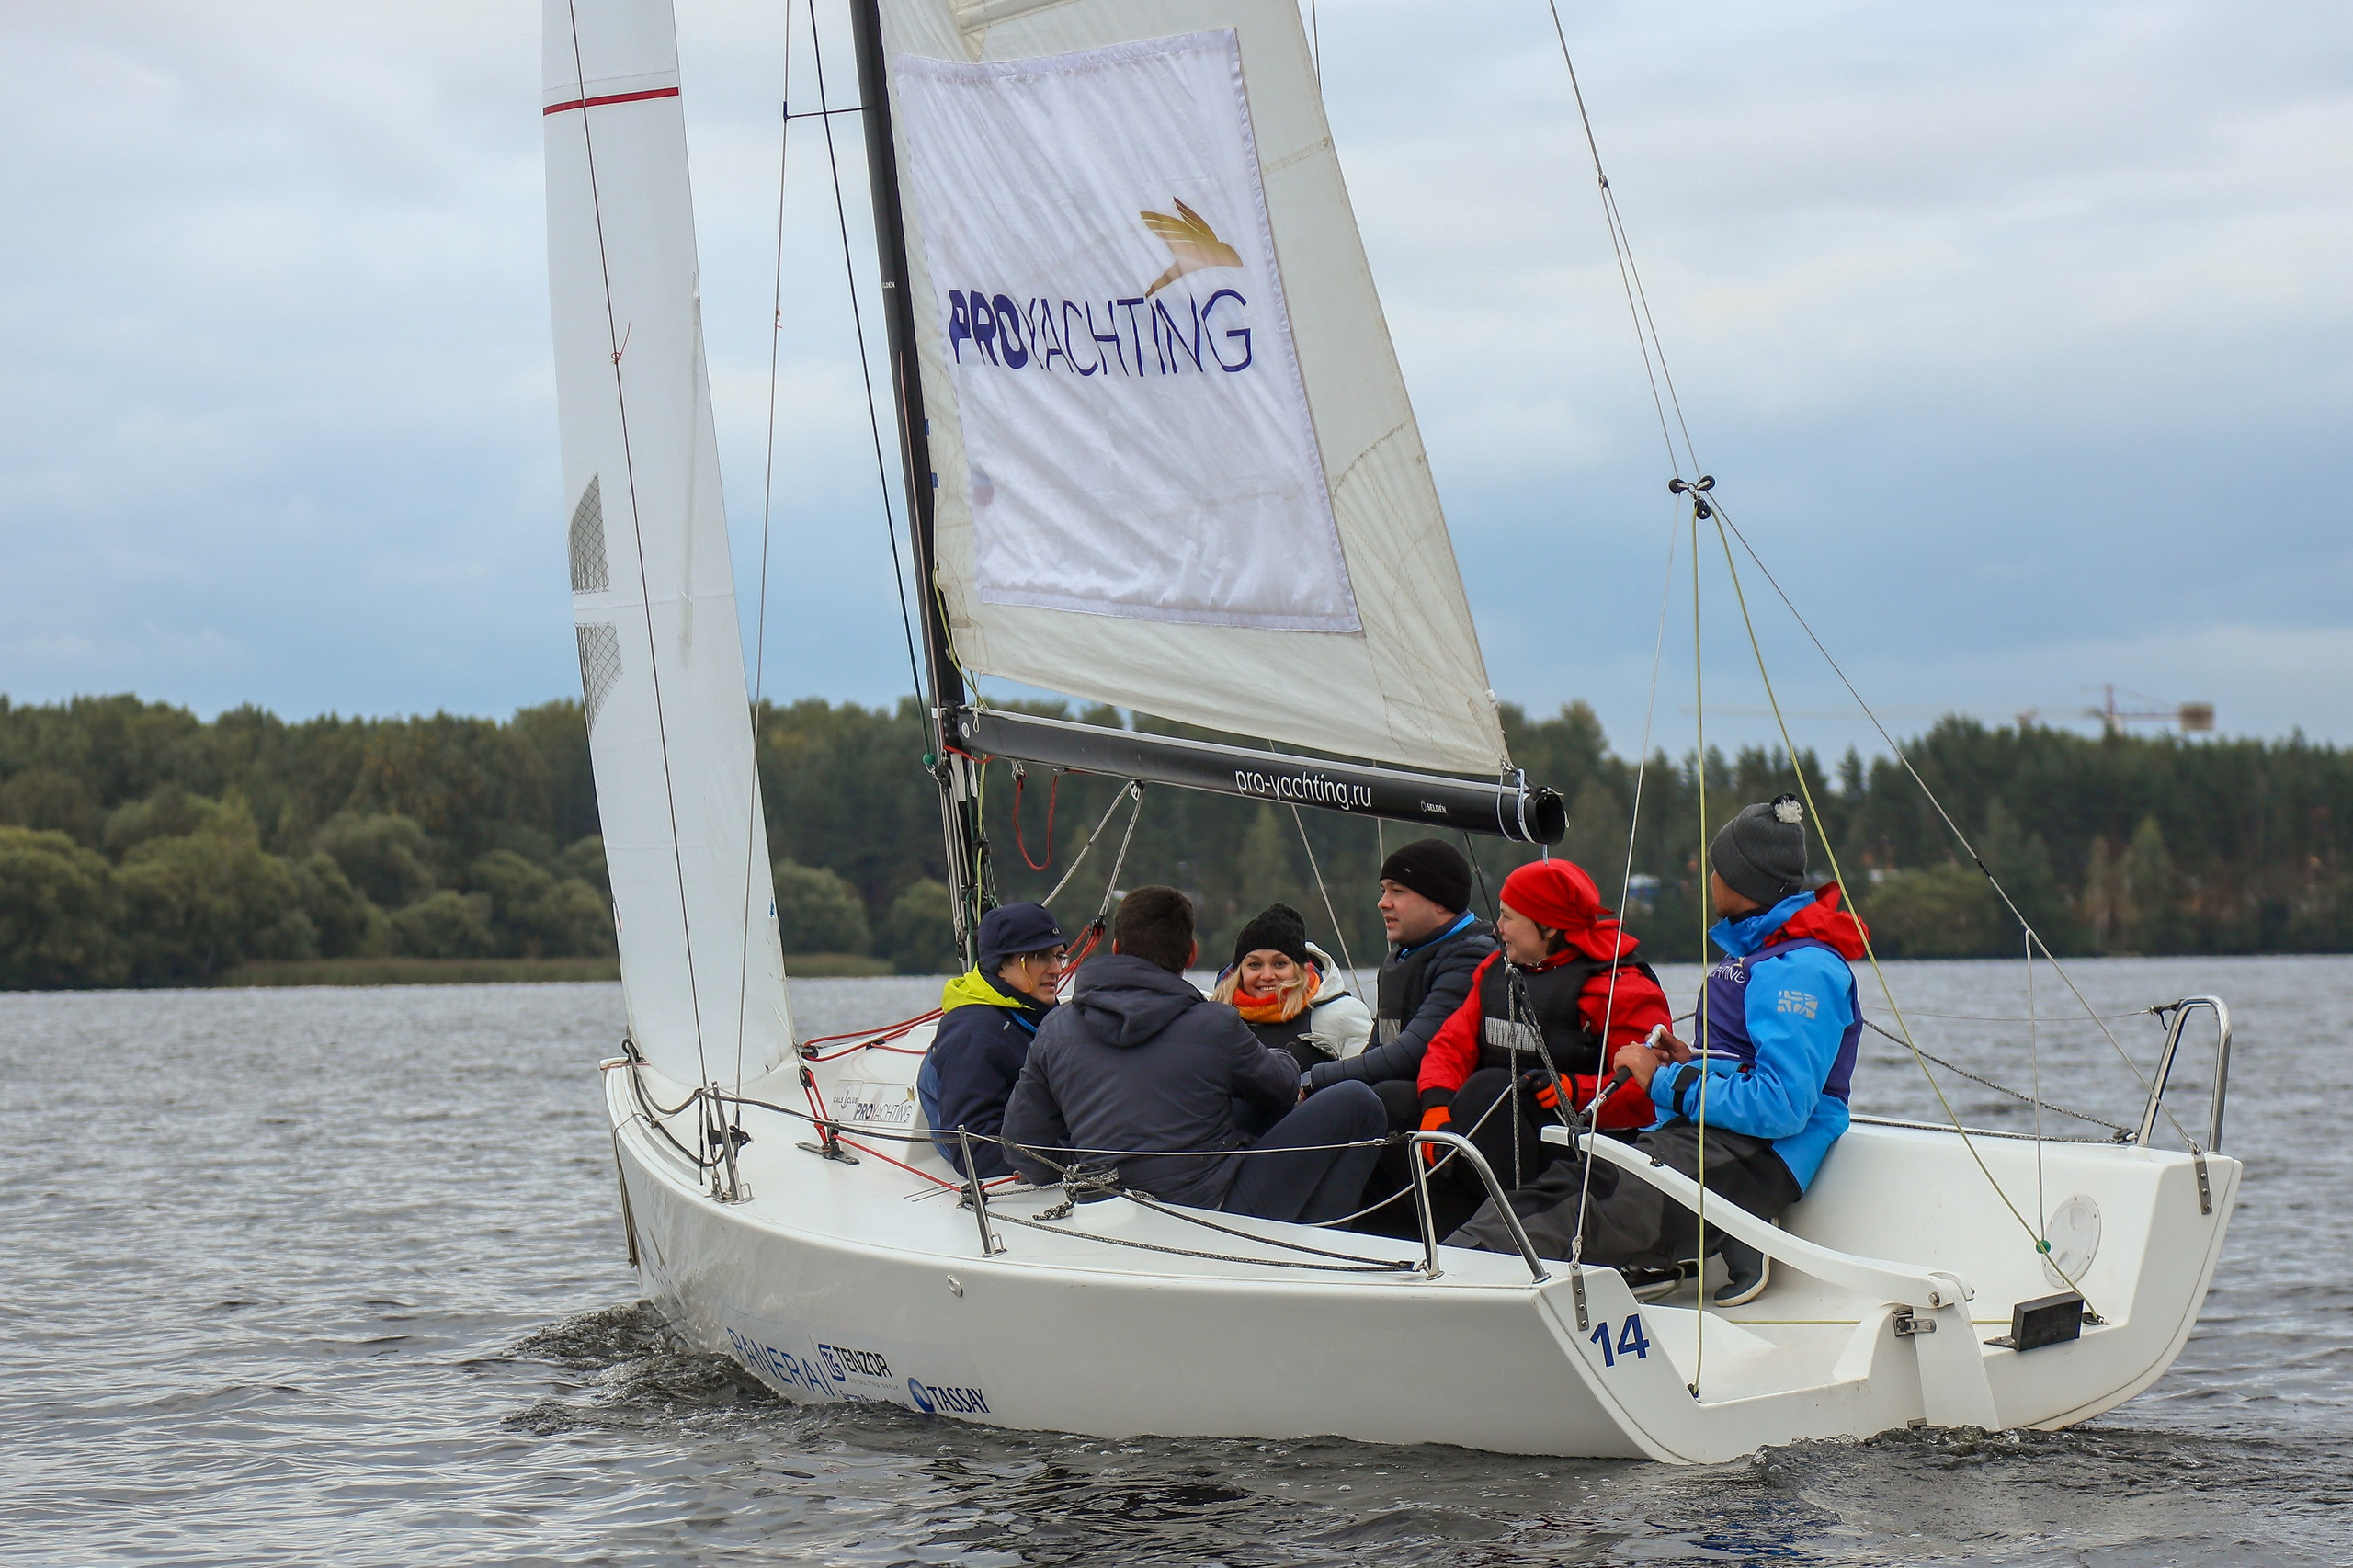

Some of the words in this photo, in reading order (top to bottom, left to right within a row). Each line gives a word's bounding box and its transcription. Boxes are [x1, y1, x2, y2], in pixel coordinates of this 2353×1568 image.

[1234, 768, 1372, 811] pro-yachting.ru
[726, 1326, 835, 1398] PANERAI
[1589, 1313, 1651, 1368] 14
[832, 1346, 893, 1379] TENZOR
[926, 1386, 991, 1414] TASSAY
